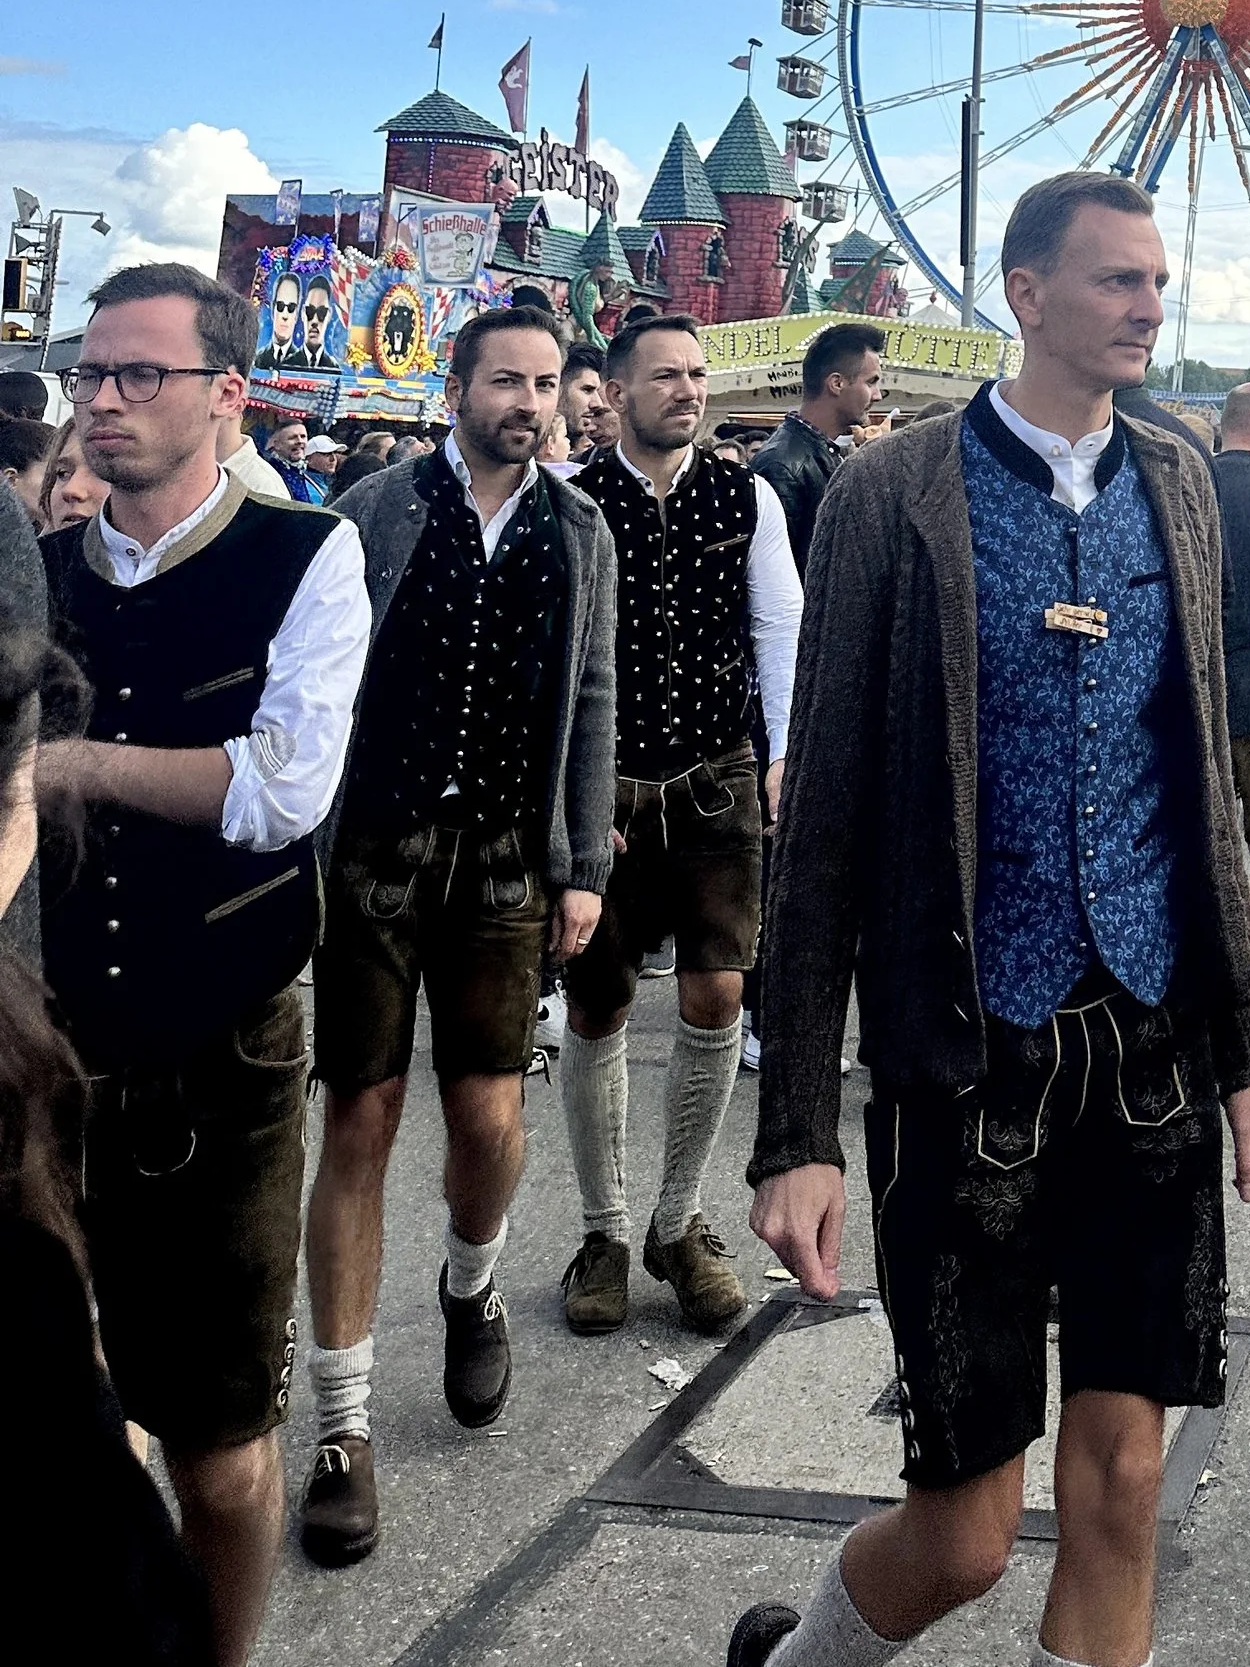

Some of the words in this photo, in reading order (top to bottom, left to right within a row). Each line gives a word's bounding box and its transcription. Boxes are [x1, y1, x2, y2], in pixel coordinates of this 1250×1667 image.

[506, 127, 619, 222] GEISTER
[422, 214, 487, 236] Schießhalle
[703, 326, 790, 364] NDEL
